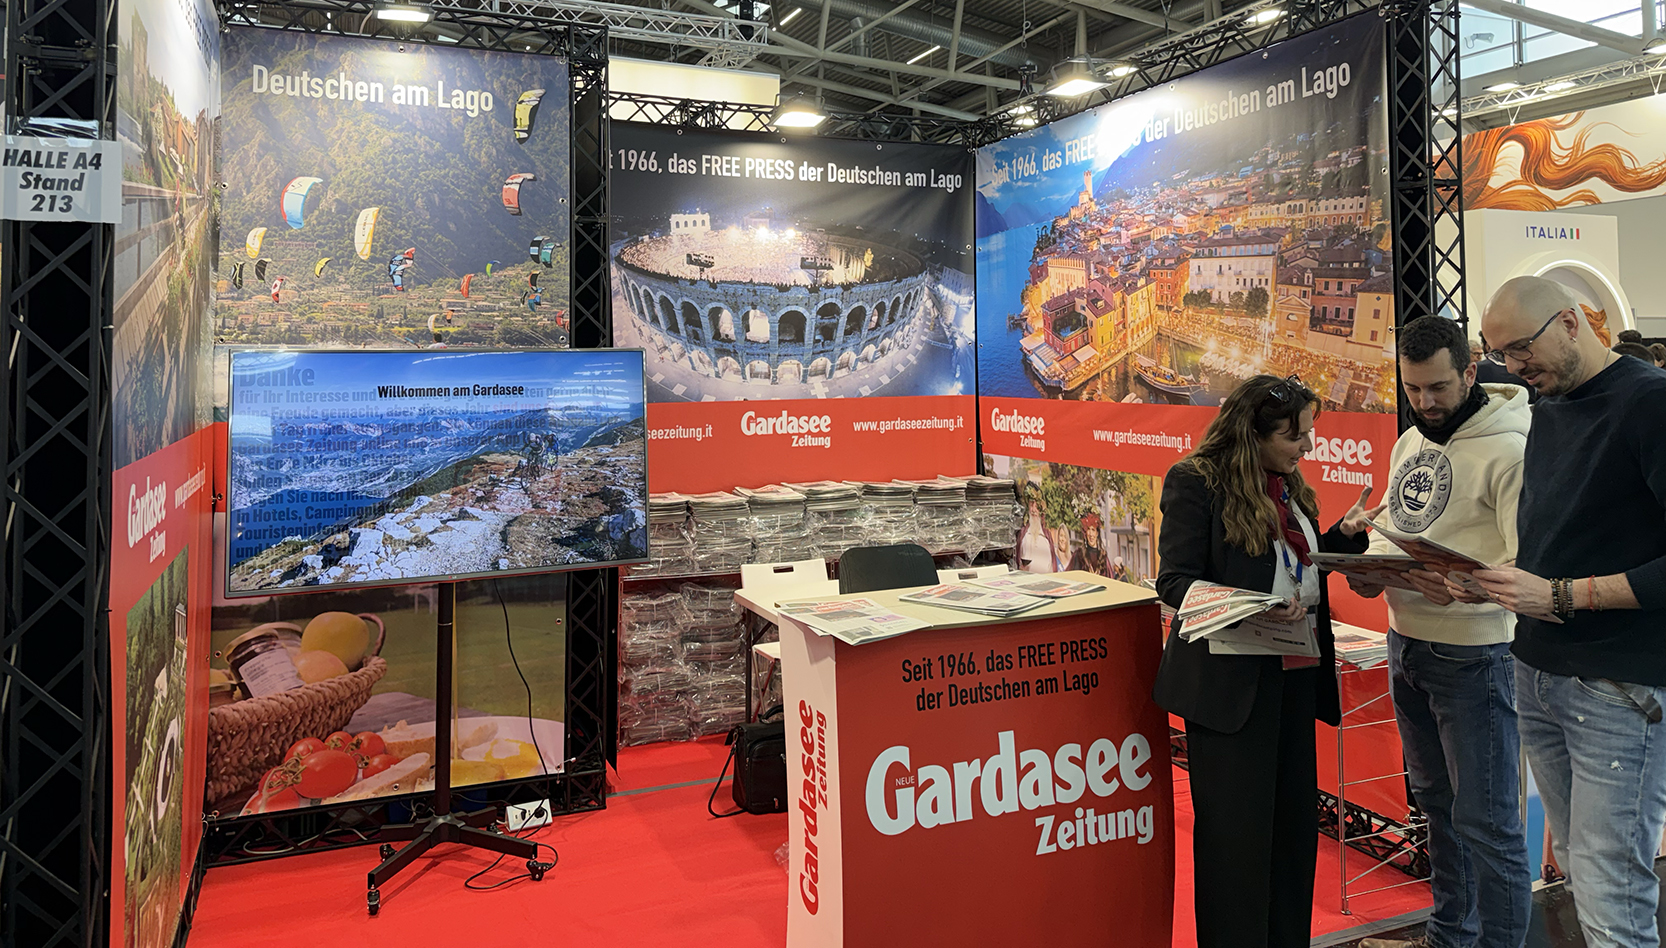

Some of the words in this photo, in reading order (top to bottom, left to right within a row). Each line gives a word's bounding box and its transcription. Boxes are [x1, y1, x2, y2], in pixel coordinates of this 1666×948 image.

[252, 64, 385, 103] Deutschen
[392, 84, 429, 107] am
[437, 80, 494, 118] Lago
[1011, 154, 1039, 181] 1966,
[1042, 148, 1063, 173] das
[1065, 134, 1096, 167] FREE
[1145, 113, 1170, 144] der
[1173, 89, 1261, 136] Deutschen
[1265, 78, 1296, 109] am
[1301, 61, 1351, 100] Lago
[2, 148, 69, 170] HALLE
[72, 151, 103, 171] A4
[618, 148, 663, 175] 1966,
[668, 152, 698, 175] das
[701, 154, 741, 178] FREE
[745, 156, 796, 182] PRESS
[798, 158, 824, 183] der
[827, 162, 902, 187] Deutschen
[905, 171, 927, 188] am
[930, 168, 963, 193] Lago
[18, 171, 86, 192] Stand
[29, 194, 74, 214] 213
[1525, 225, 1568, 240] ITALIA
[239, 389, 260, 404] für
[263, 389, 285, 404] Ihr
[285, 389, 350, 403] Interesse
[377, 385, 451, 398] Willkommen
[452, 386, 471, 398] am
[473, 384, 525, 397] Gardasee
[647, 423, 713, 442] seezeitung.it
[741, 410, 832, 436] Gardasee
[853, 415, 964, 435] www.gardaseezeitung.it
[991, 407, 1045, 436] Gardasee
[791, 434, 831, 449] Zeitung
[1019, 435, 1046, 453] Zeitung
[1092, 427, 1193, 451] www.gardaseezeitung.it
[1303, 427, 1373, 466] dasee
[1321, 465, 1374, 489] Zeitung
[127, 475, 167, 549] Gardasee
[252, 506, 301, 523] Hotels,
[901, 656, 934, 684] Seit
[937, 651, 981, 680] 1966,
[985, 649, 1013, 673] das
[1017, 642, 1056, 669] FREE
[1060, 636, 1108, 664] PRESS
[916, 687, 944, 712] der
[949, 677, 1032, 708] Deutschen
[1035, 676, 1060, 697] am
[1063, 670, 1100, 696] Lago
[815, 709, 829, 811] Zeitung
[865, 730, 1153, 836] Gardasee
[895, 775, 916, 787] NEUE
[799, 699, 819, 916] Gardasee
[1035, 804, 1155, 856] Zeitung
